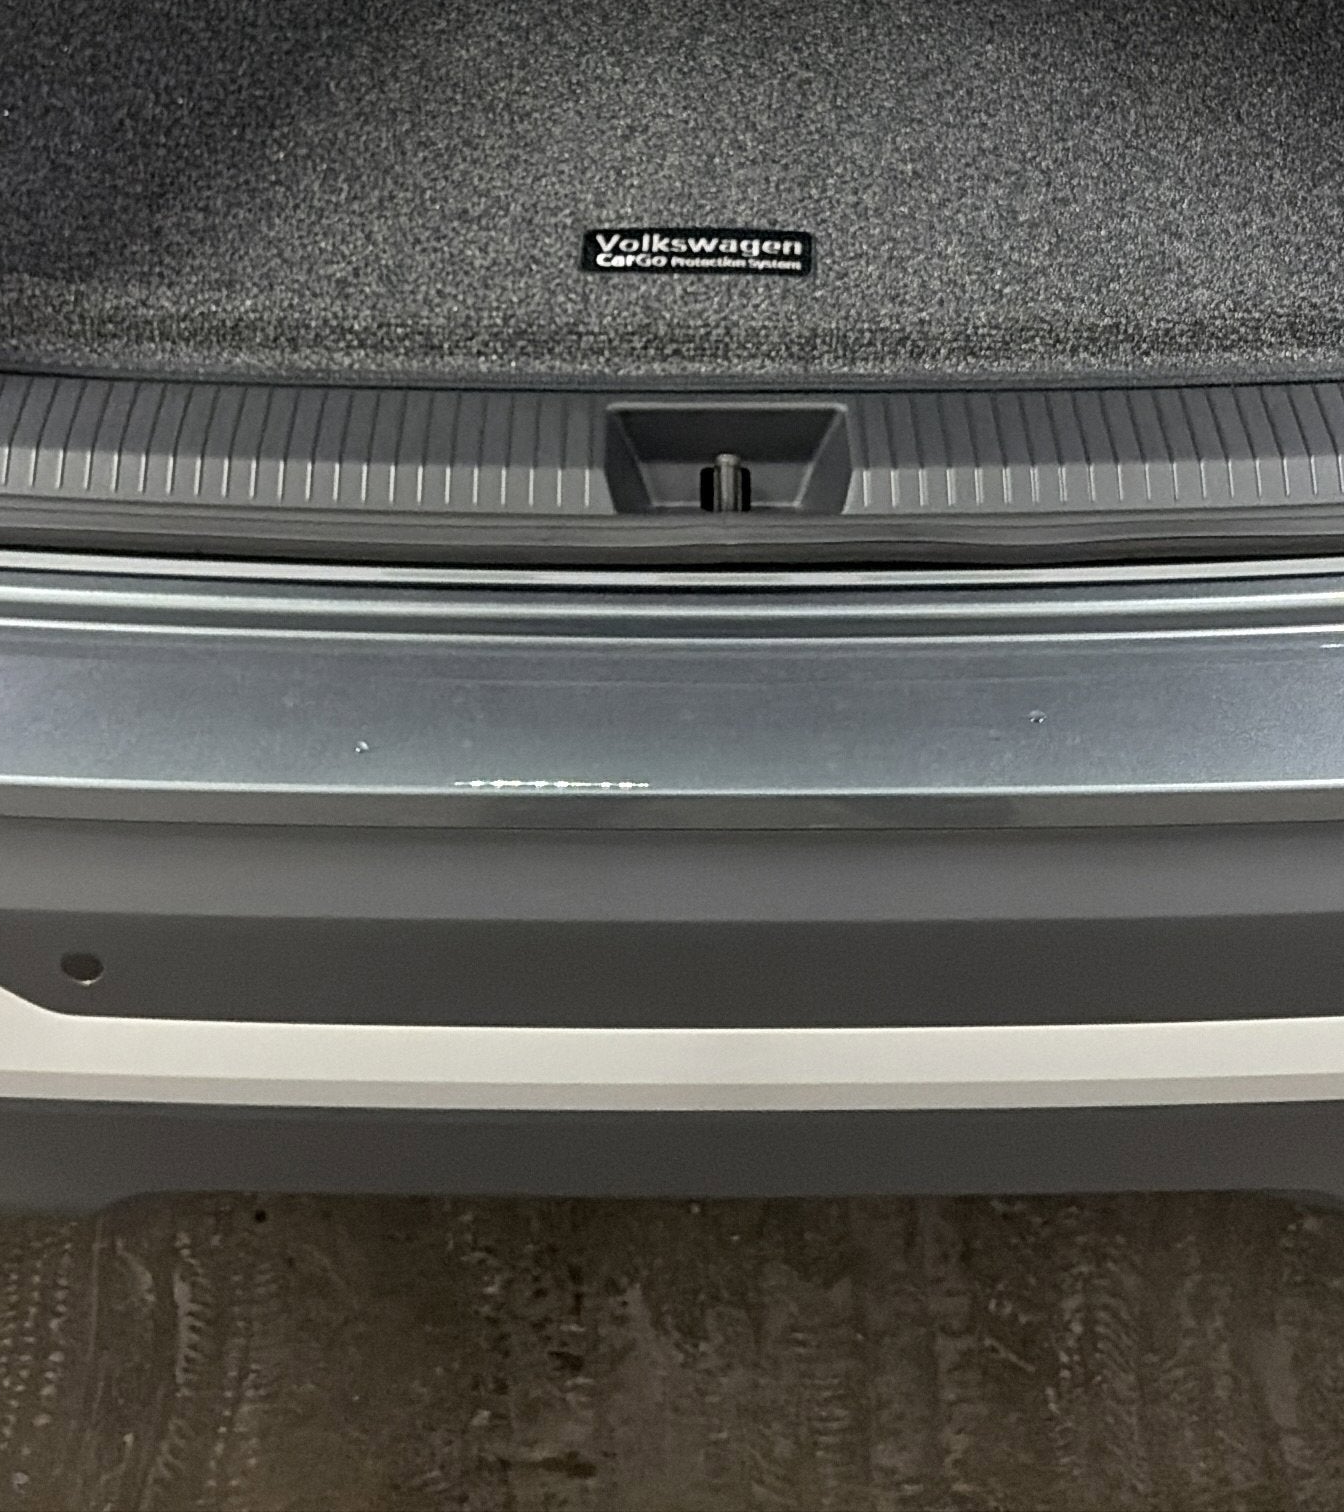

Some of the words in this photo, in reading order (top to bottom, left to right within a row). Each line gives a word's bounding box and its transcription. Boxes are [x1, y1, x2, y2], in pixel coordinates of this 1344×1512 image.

[595, 233, 803, 256] Volkswagen
[670, 256, 746, 268] Protection
[747, 258, 802, 271] System
